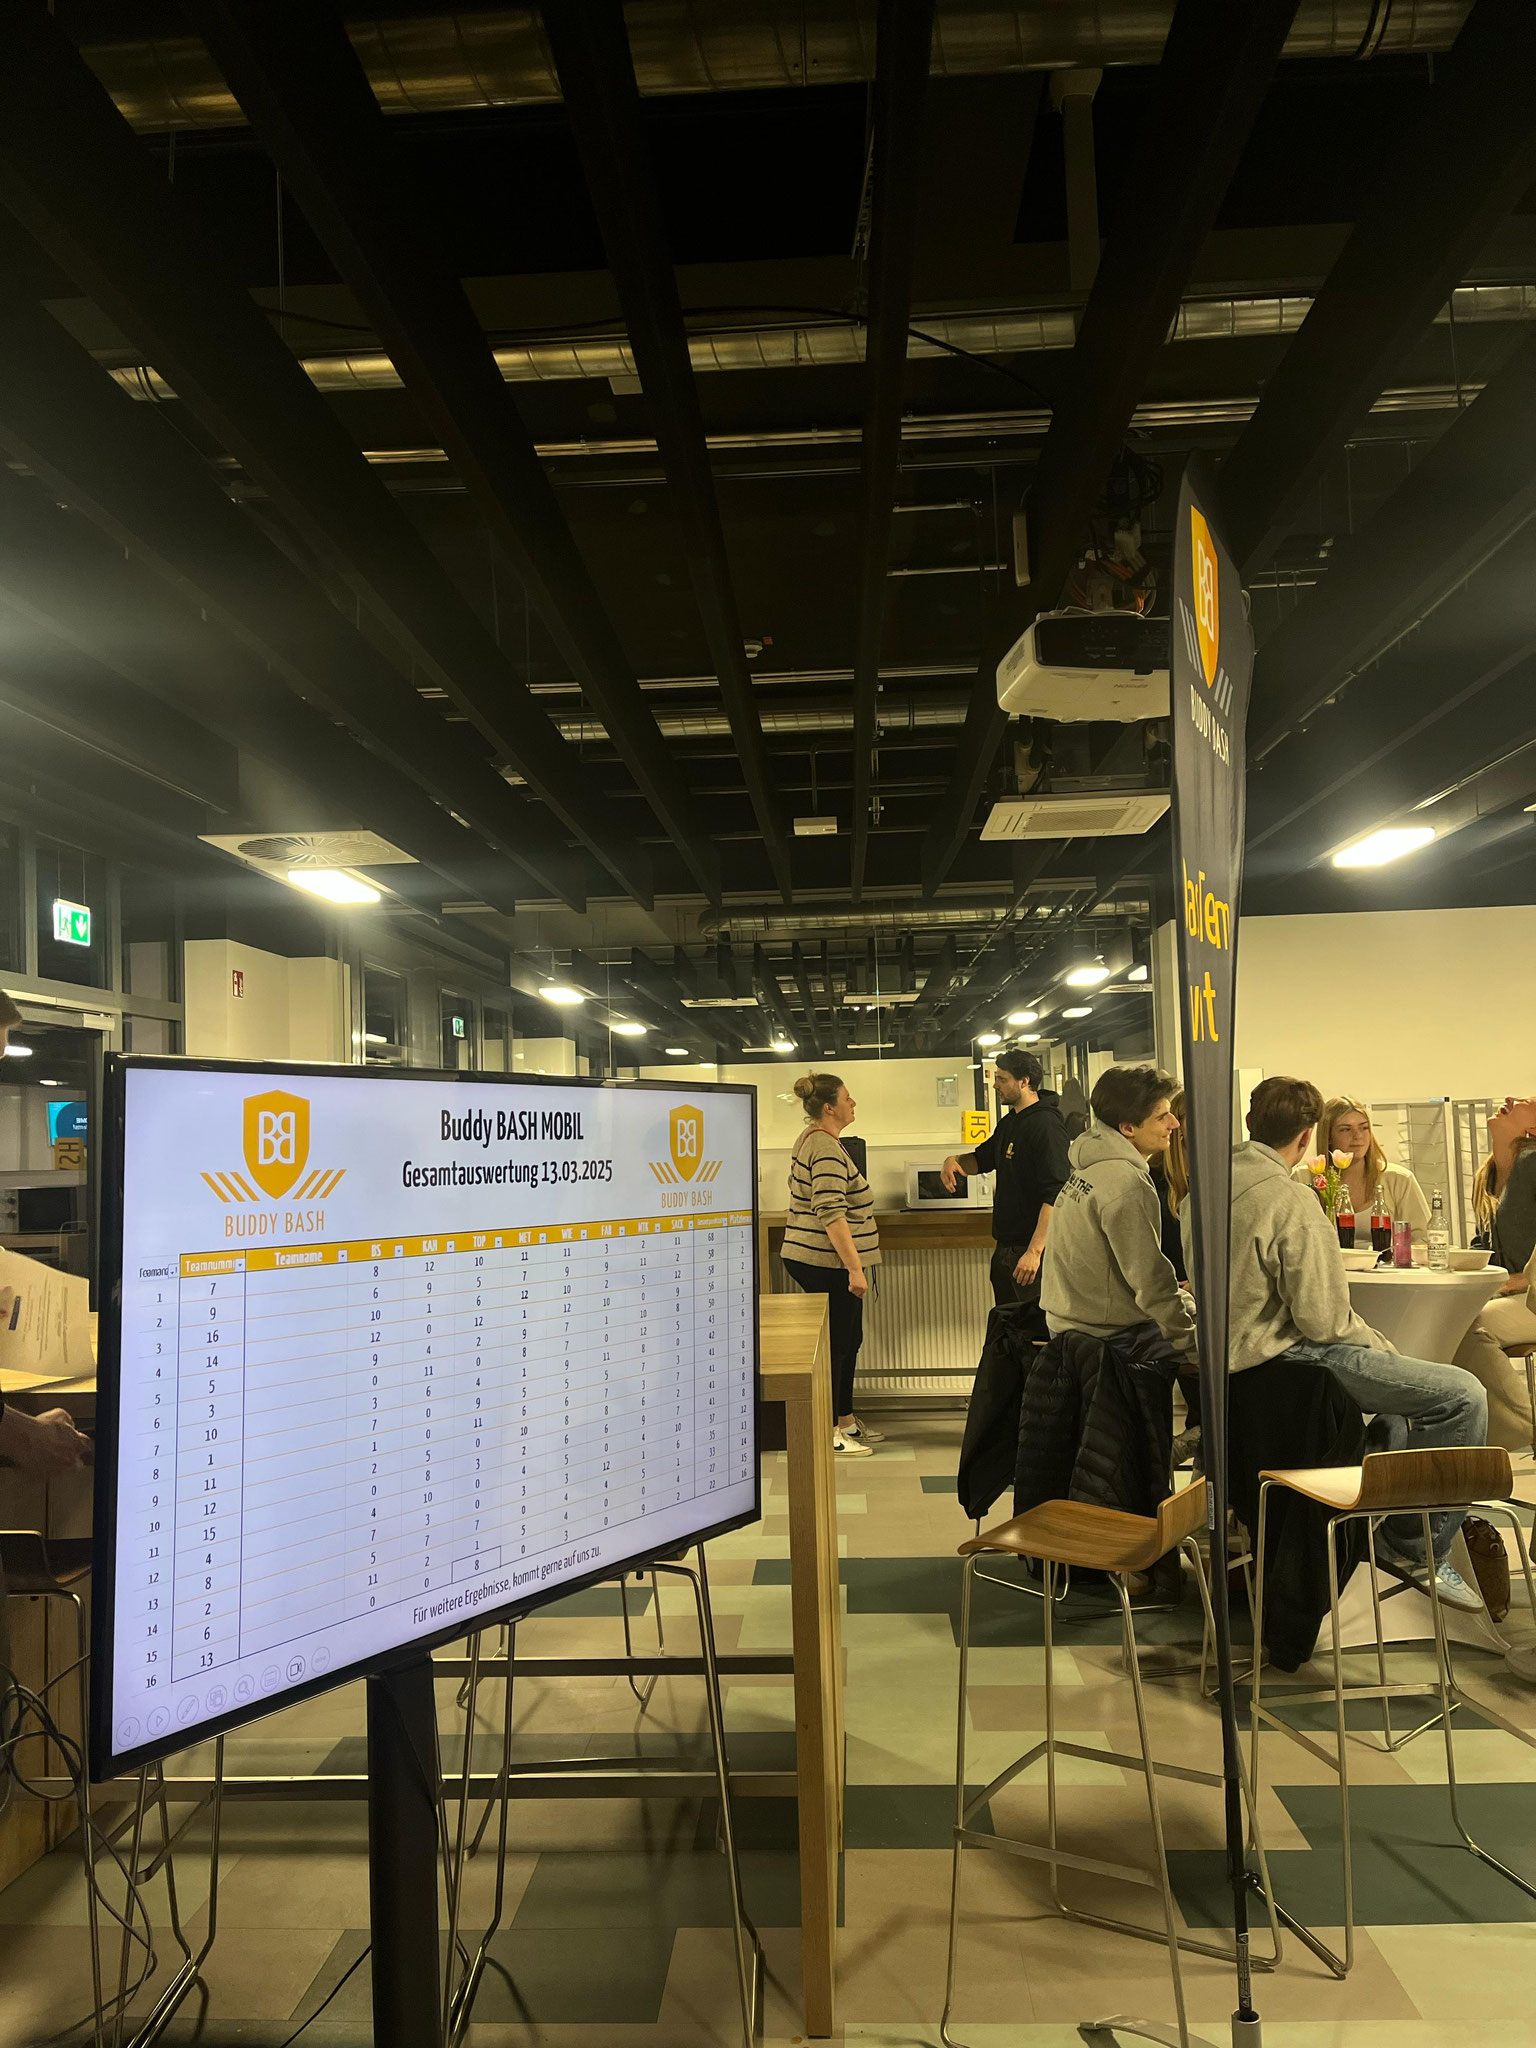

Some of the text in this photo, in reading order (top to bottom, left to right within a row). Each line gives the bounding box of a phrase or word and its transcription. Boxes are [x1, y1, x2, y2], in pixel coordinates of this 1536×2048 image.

[441, 1108, 584, 1148] Buddy BASH MOBIL
[402, 1159, 613, 1188] Gesamtauswertung 13.03.2025
[661, 1190, 713, 1209] BUDDY BASH
[185, 1258, 235, 1273] Teamnumm
[274, 1252, 323, 1266] Teamname
[472, 1235, 487, 1248] TOP
[224, 1210, 325, 1238] BUDDY BASH
[156, 1276, 482, 1329] 2 9 6 9 5
[157, 1292, 163, 1304] 1
[210, 1282, 217, 1296] 7
[373, 1265, 379, 1278] 8
[425, 1260, 435, 1272] 12
[474, 1256, 484, 1268] 10
[520, 1251, 529, 1262] 11
[563, 1247, 571, 1258] 11
[604, 1243, 609, 1255] 3
[641, 1239, 646, 1249] 2
[674, 1236, 681, 1246] 11
[707, 1232, 715, 1242] 68
[155, 1316, 484, 1379] 4 14 12 0 12
[156, 1295, 482, 1355] 3 16 10 1 6
[153, 1417, 161, 1430] 6
[208, 1403, 215, 1419] 3
[372, 1374, 378, 1386] 0
[424, 1365, 434, 1377] 11
[475, 1356, 481, 1368] 0
[522, 1346, 527, 1358] 8
[564, 1340, 570, 1351] 7
[604, 1332, 609, 1344] 0
[639, 1326, 648, 1337] 12
[675, 1320, 680, 1331] 5
[708, 1314, 715, 1325] 43
[154, 1336, 482, 1406] 5 5 9 4 2
[152, 1397, 481, 1481] 8 1 7 0 9
[154, 1376, 481, 1457] 7 10 3 6 4
[148, 1546, 160, 1559] 11
[203, 1526, 216, 1542] 15
[371, 1484, 377, 1496] 0
[425, 1469, 431, 1482] 8
[475, 1457, 481, 1471] 3
[521, 1445, 527, 1456] 2
[564, 1433, 569, 1445] 6
[604, 1423, 609, 1434] 6
[641, 1414, 646, 1426] 9
[676, 1405, 681, 1416] 7
[708, 1396, 715, 1406] 41
[149, 1436, 481, 1533] 10 12 2 5 0
[152, 1417, 483, 1508] 9 11 1 0 11
[147, 1498, 480, 1611] 13 8 7 3 0
[148, 1478, 481, 1585] 12 4 4 10 0
[145, 1467, 748, 1689] 16 13 0 0 8 0 3 0 9 2 22 16
[146, 1519, 480, 1637] 14 2 5 7 7
[146, 1540, 480, 1664] 15 6 11 2 1
[413, 1545, 602, 1624] Für weitere Ergebnisse, kommt gerne auf uns zu.
